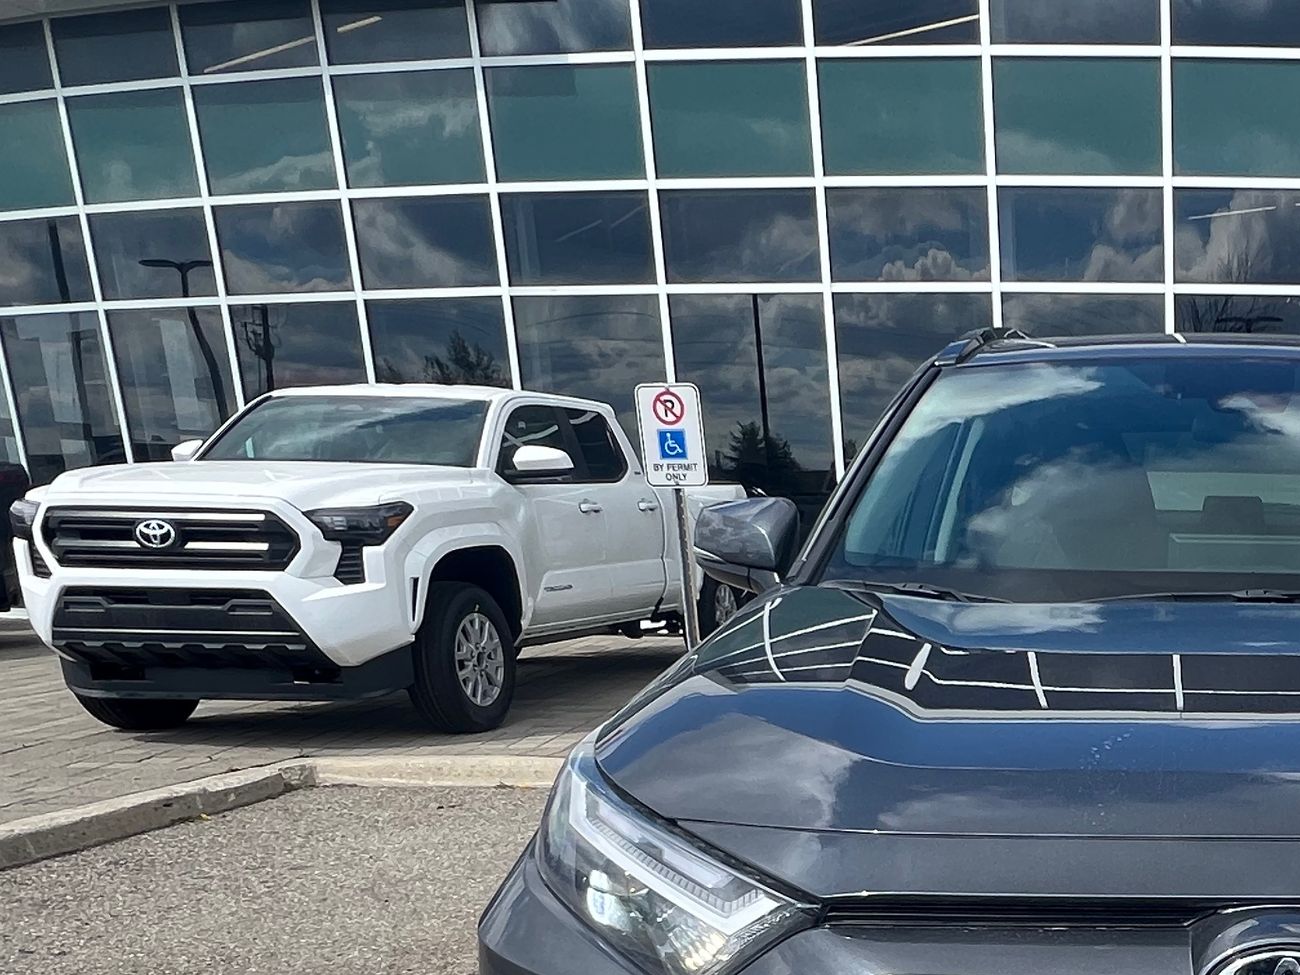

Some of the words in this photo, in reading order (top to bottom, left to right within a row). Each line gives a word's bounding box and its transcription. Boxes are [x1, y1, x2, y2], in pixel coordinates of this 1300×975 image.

[653, 463, 664, 472] BY
[666, 463, 698, 472] PERMIT
[666, 472, 687, 481] ONLY
